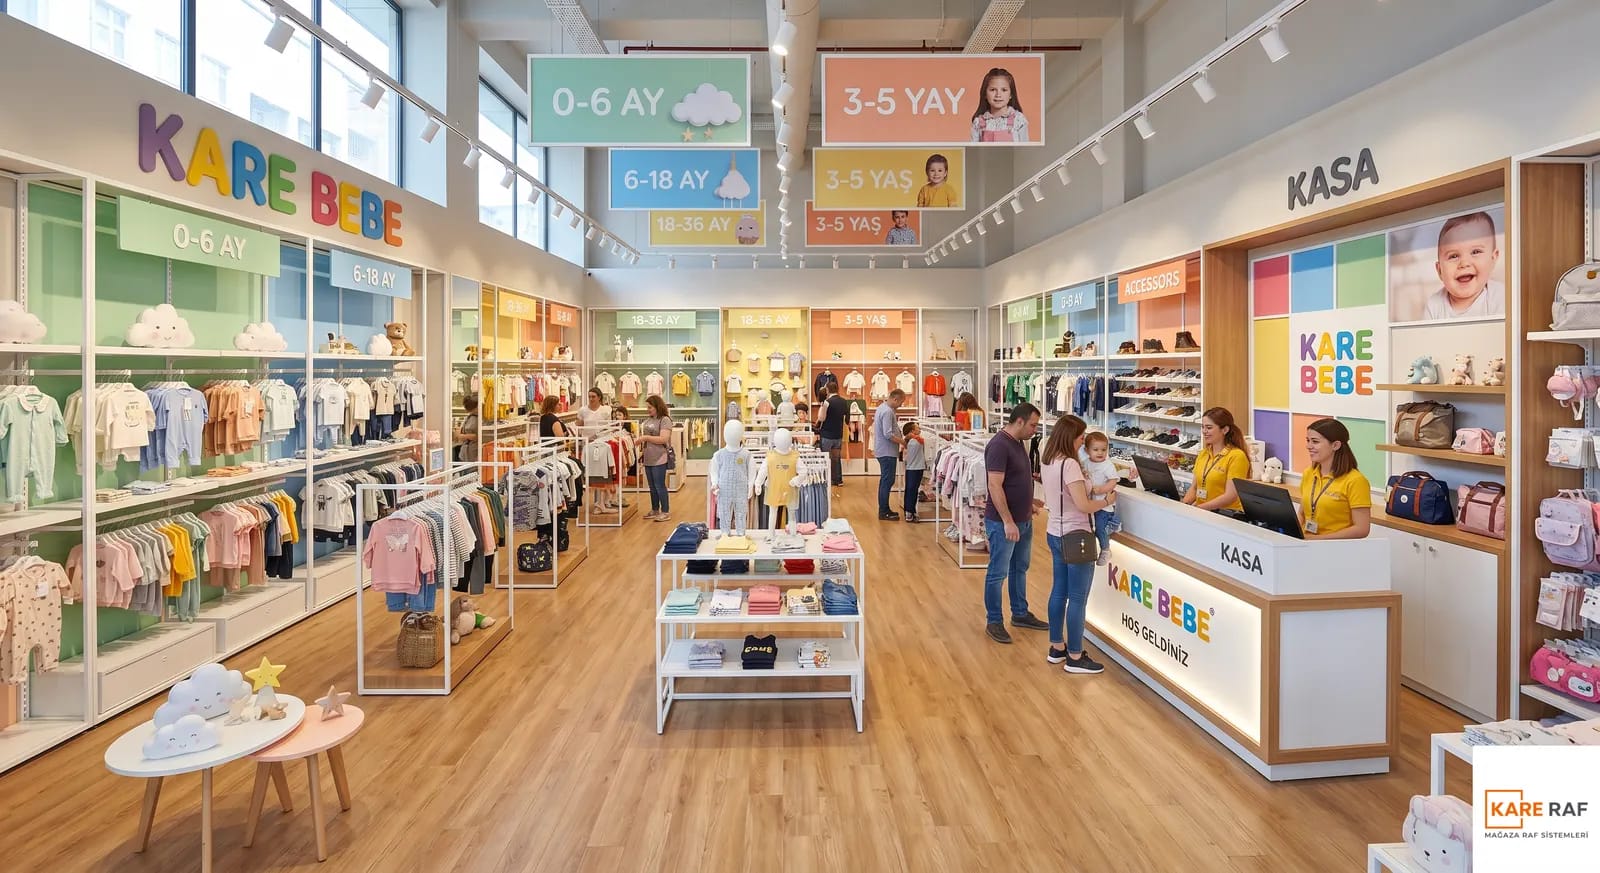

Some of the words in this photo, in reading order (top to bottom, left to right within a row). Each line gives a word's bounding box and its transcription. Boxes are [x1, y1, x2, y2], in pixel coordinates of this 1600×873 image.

[551, 86, 612, 117] 0-6
[620, 87, 665, 116] AY
[843, 86, 896, 117] 3-5
[904, 87, 966, 116] YAY
[137, 102, 298, 216] KARE
[310, 170, 404, 248] BEBE
[623, 169, 673, 191] 6-18
[679, 170, 710, 190] AY
[825, 169, 864, 191] 3-5
[868, 169, 913, 194] YAŞ
[1287, 147, 1380, 211] KASA
[656, 216, 704, 232] 18-36
[707, 216, 732, 232] AY
[815, 216, 844, 232] 3-5
[847, 216, 882, 235] YAŞ
[173, 223, 214, 256] 0-6
[218, 233, 248, 261] AY
[353, 264, 380, 288] 6-18
[381, 270, 397, 290] AY
[1124, 270, 1181, 297] ACCESSORS
[631, 314, 663, 326] 18-36
[664, 314, 681, 326] AY
[844, 314, 864, 326] 3-5
[1301, 328, 1374, 362] KARE
[1301, 365, 1374, 396] BEBE
[1220, 542, 1264, 576] KASA
[1107, 562, 1153, 611] KARE
[1121, 612, 1141, 637] HOŞ
[1142, 626, 1190, 668] GELDİNİZ
